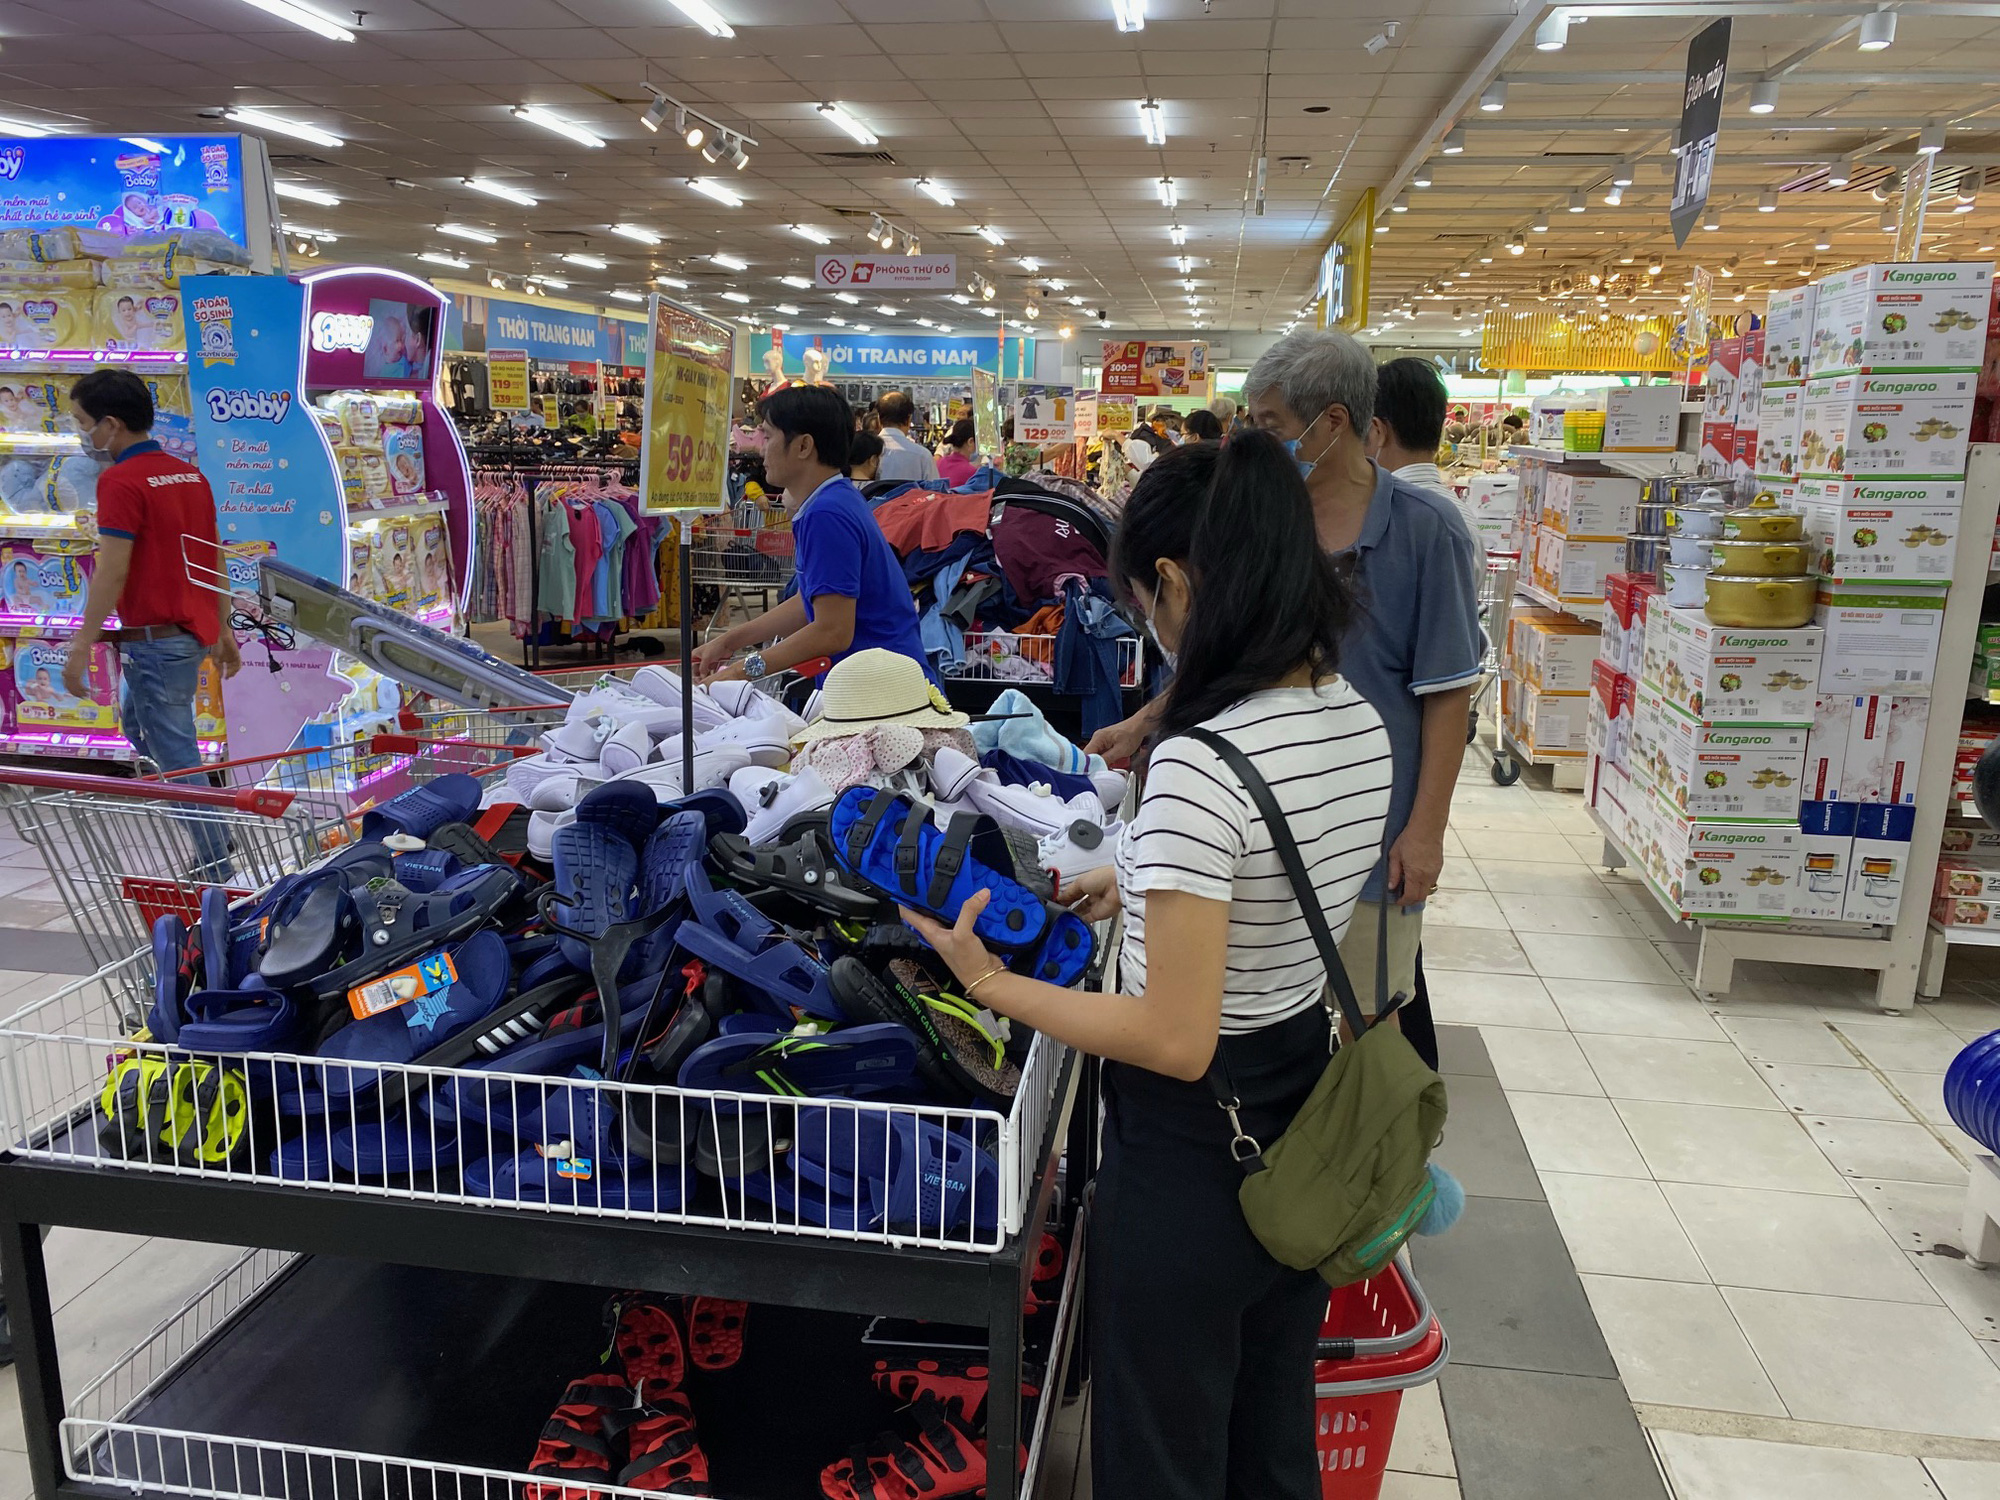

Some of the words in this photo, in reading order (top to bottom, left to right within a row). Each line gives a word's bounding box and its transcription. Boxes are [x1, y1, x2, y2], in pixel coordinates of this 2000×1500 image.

[876, 265, 911, 274] PHÒNG
[1882, 269, 1958, 285] Kangaroo
[209, 308, 233, 320] SINH
[497, 314, 530, 341] THỜI
[531, 321, 570, 346] TRANG
[571, 327, 596, 349] NAM
[858, 348, 928, 365] TRANG
[932, 349, 978, 366] NAM
[1862, 380, 1938, 395] Kangaroo
[206, 388, 291, 425] Bobby
[226, 458, 247, 469] mềm
[147, 472, 202, 488] SUNHOUSE
[1853, 487, 1927, 502] Kangaroo
[220, 501, 237, 512] cho
[1719, 635, 1789, 649] Kangaroo
[31, 647, 70, 666] Bobb
[1703, 733, 1771, 746] Kangaroo
[393, 785, 423, 805] VIETSAN
[1823, 803, 1833, 832] Luminarc
[1881, 807, 1892, 836] Luminarc
[1698, 830, 1766, 844] Kangaroo
[404, 861, 442, 873] VIETSAN
[924, 1172, 967, 1193] VIESAN
